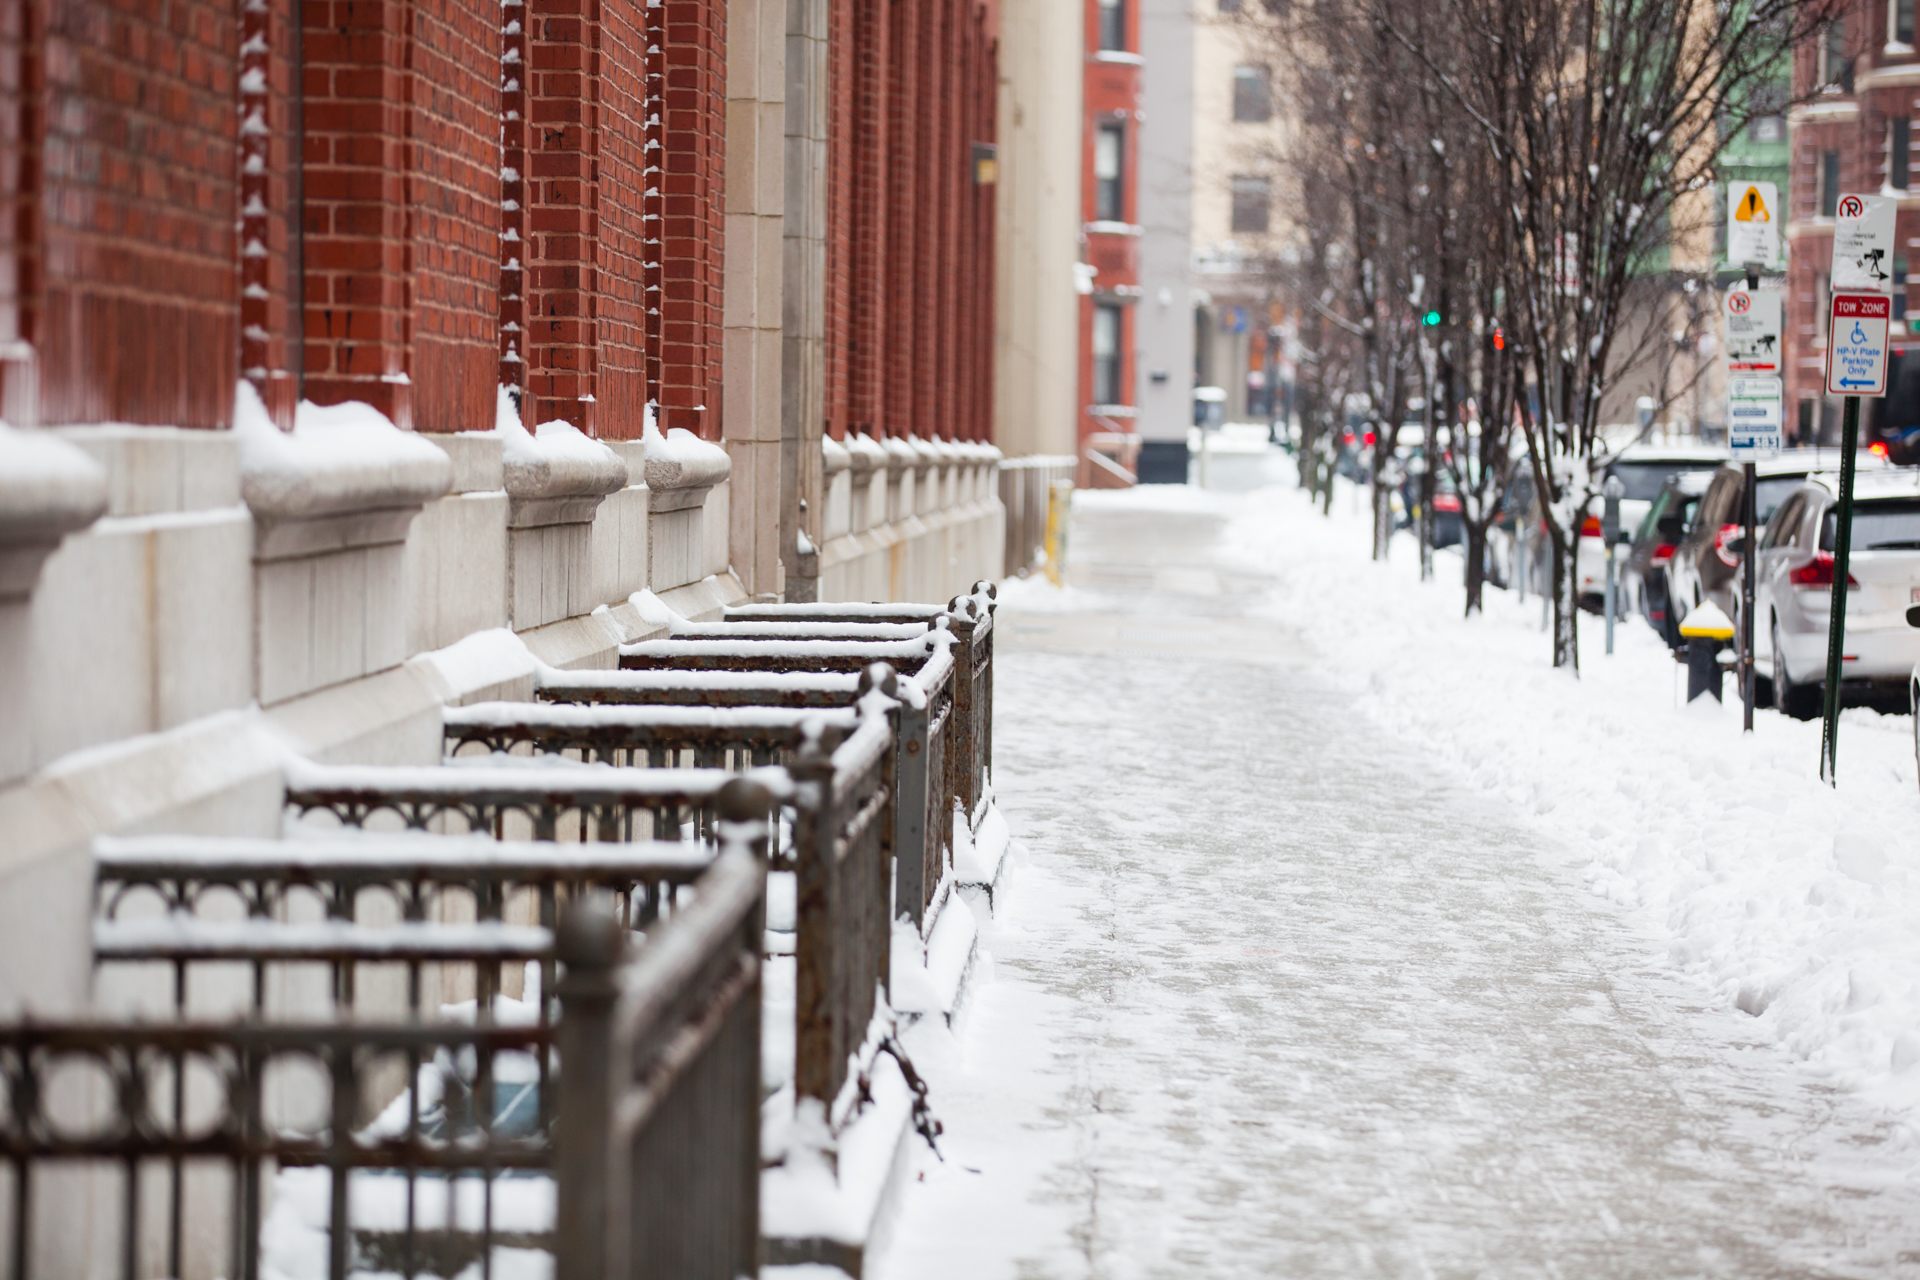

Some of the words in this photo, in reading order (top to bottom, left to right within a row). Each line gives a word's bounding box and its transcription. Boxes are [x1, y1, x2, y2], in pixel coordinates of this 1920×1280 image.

[1838, 302, 1857, 313] TOW
[1861, 303, 1885, 314] ZONE
[1837, 347, 1857, 355] HP-V
[1860, 348, 1880, 356] Plate
[1842, 356, 1874, 368] Parking
[1848, 366, 1867, 377] Only
